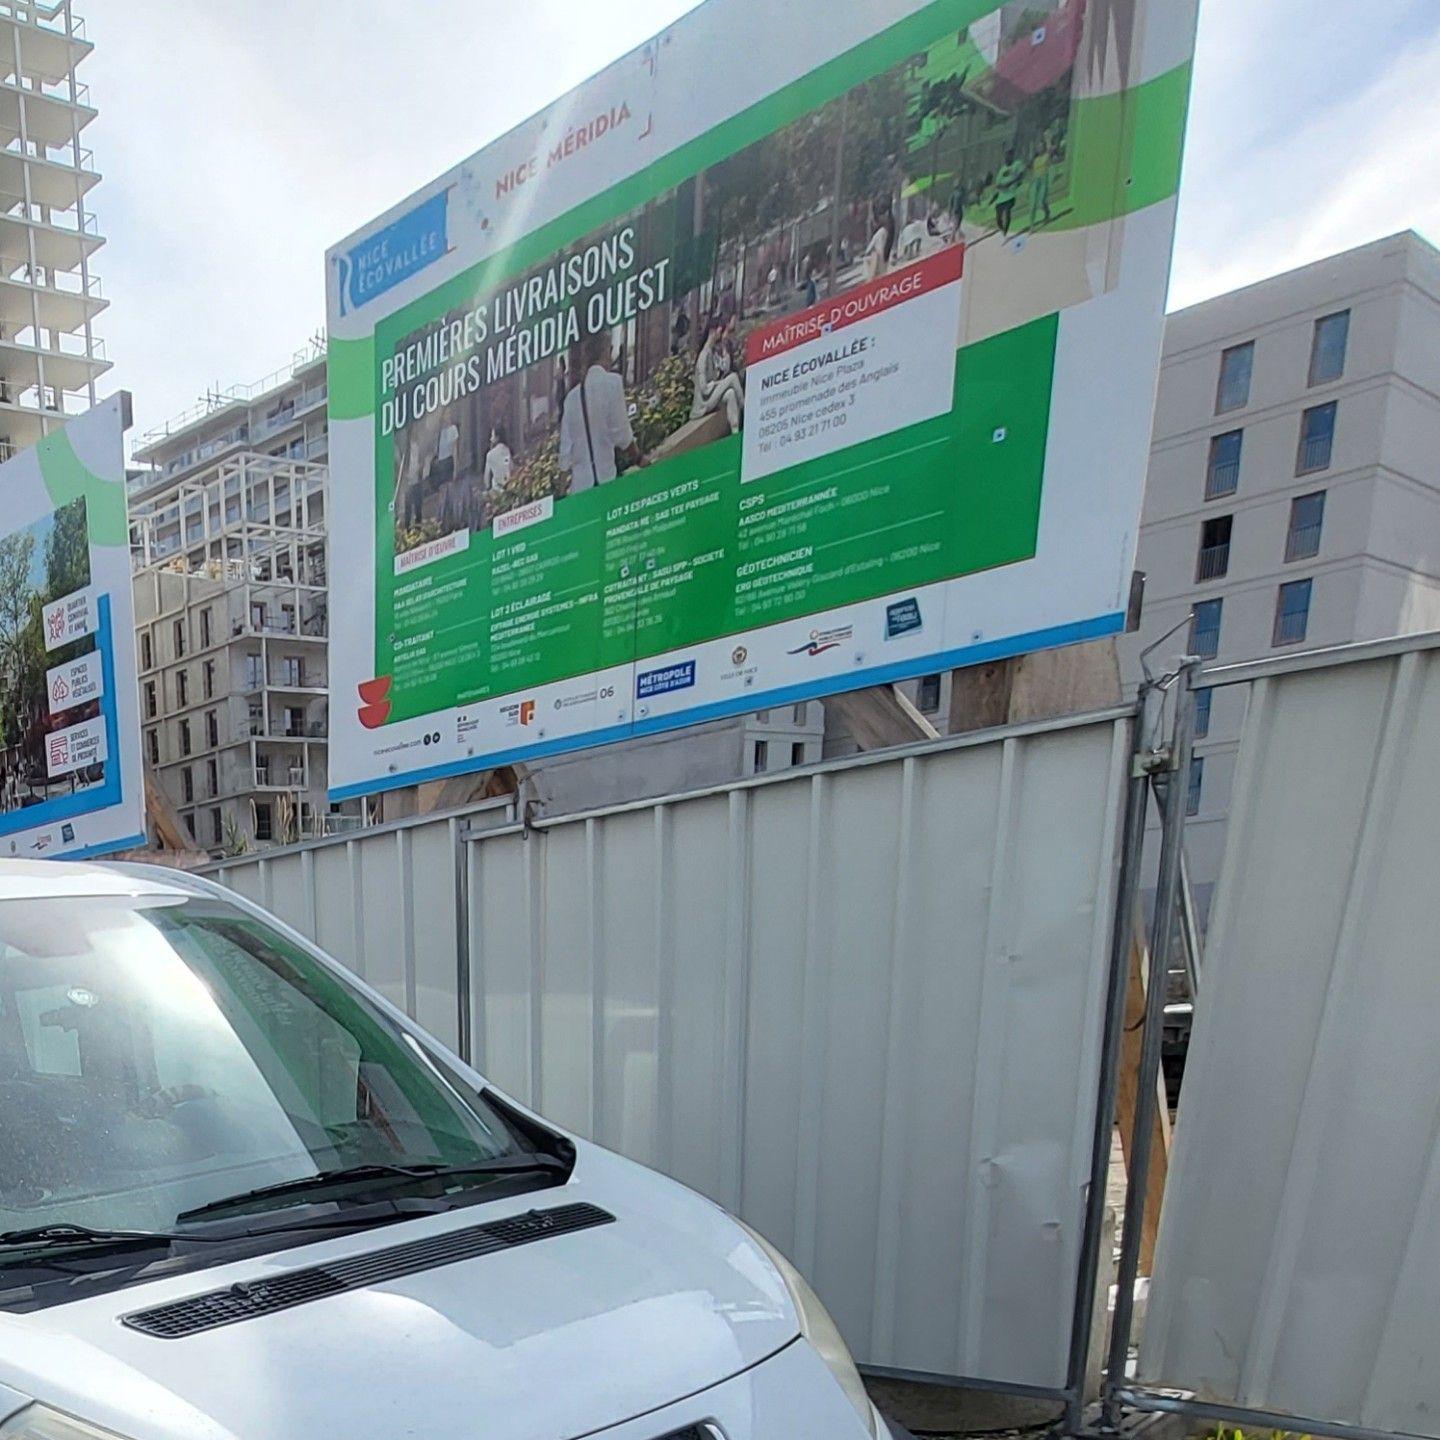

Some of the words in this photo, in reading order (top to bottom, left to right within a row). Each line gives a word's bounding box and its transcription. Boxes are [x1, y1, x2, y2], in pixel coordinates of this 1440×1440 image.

[496, 157, 538, 199] NICE
[547, 101, 631, 168] MÉRIDIA
[358, 239, 389, 270] NICE
[381, 304, 488, 395] PREMIÈRES
[493, 228, 635, 334] LIVRAISONS
[762, 312, 826, 353] MAÎTRISE
[830, 272, 923, 325] D'OUVRAGE
[381, 397, 407, 437] DU
[412, 354, 480, 420] COURS
[486, 304, 580, 384] MÉRIDIA
[587, 258, 670, 334] OUEST
[761, 368, 790, 391] NICE
[792, 335, 868, 379] ÉCOVALLÉE
[760, 382, 809, 407] Immeuble
[811, 371, 833, 390] Nice
[836, 360, 865, 379] Plaza
[760, 408, 777, 424] 455
[778, 388, 836, 417] promenade
[838, 379, 857, 394] des
[859, 362, 900, 384] Anglais
[790, 410, 814, 429] Nice
[815, 401, 847, 420] cedex
[848, 394, 856, 406] 3
[779, 434, 793, 448] 04
[794, 429, 808, 442] 93
[809, 426, 820, 438] 21
[820, 420, 832, 434] 71
[832, 414, 847, 429] 00
[606, 506, 623, 521] LOT
[623, 504, 630, 516] 3
[630, 491, 669, 513] ESPACES
[670, 479, 700, 499] VERTS
[739, 493, 766, 511] CSPS
[738, 511, 767, 528] AASCO
[492, 549, 507, 563] LOT
[490, 605, 505, 619] LOT
[599, 686, 614, 699] 06
[640, 665, 692, 687] MÉTROPOLE
